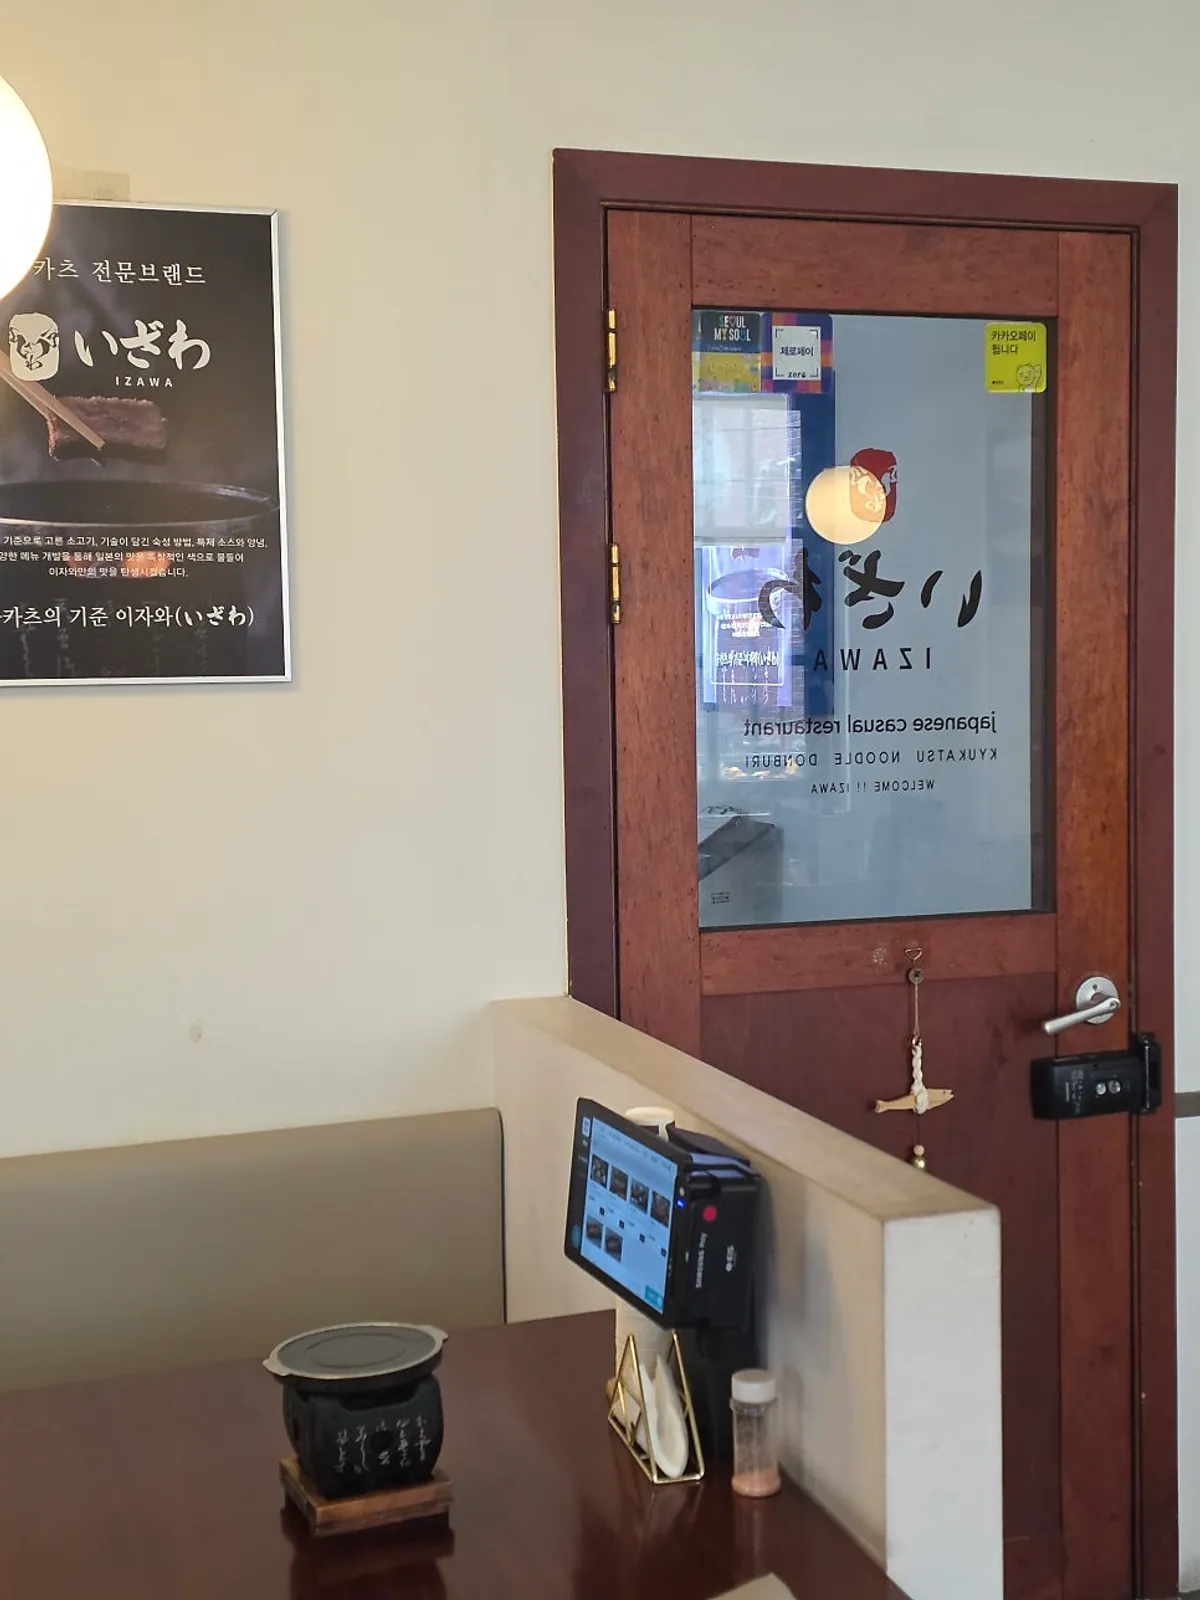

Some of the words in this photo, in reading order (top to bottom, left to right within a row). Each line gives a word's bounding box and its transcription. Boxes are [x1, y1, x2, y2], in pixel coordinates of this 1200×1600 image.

[91, 260, 206, 286] 전문브랜드
[991, 330, 1036, 342] 카카오페이
[74, 319, 211, 370] いざわ
[780, 346, 814, 357] 제로페이
[115, 376, 173, 388] IZAWA
[100, 536, 128, 547] 기술이
[217, 537, 245, 548] 소스와
[0, 606, 61, 629] 카츠의
[69, 606, 109, 628] 기준
